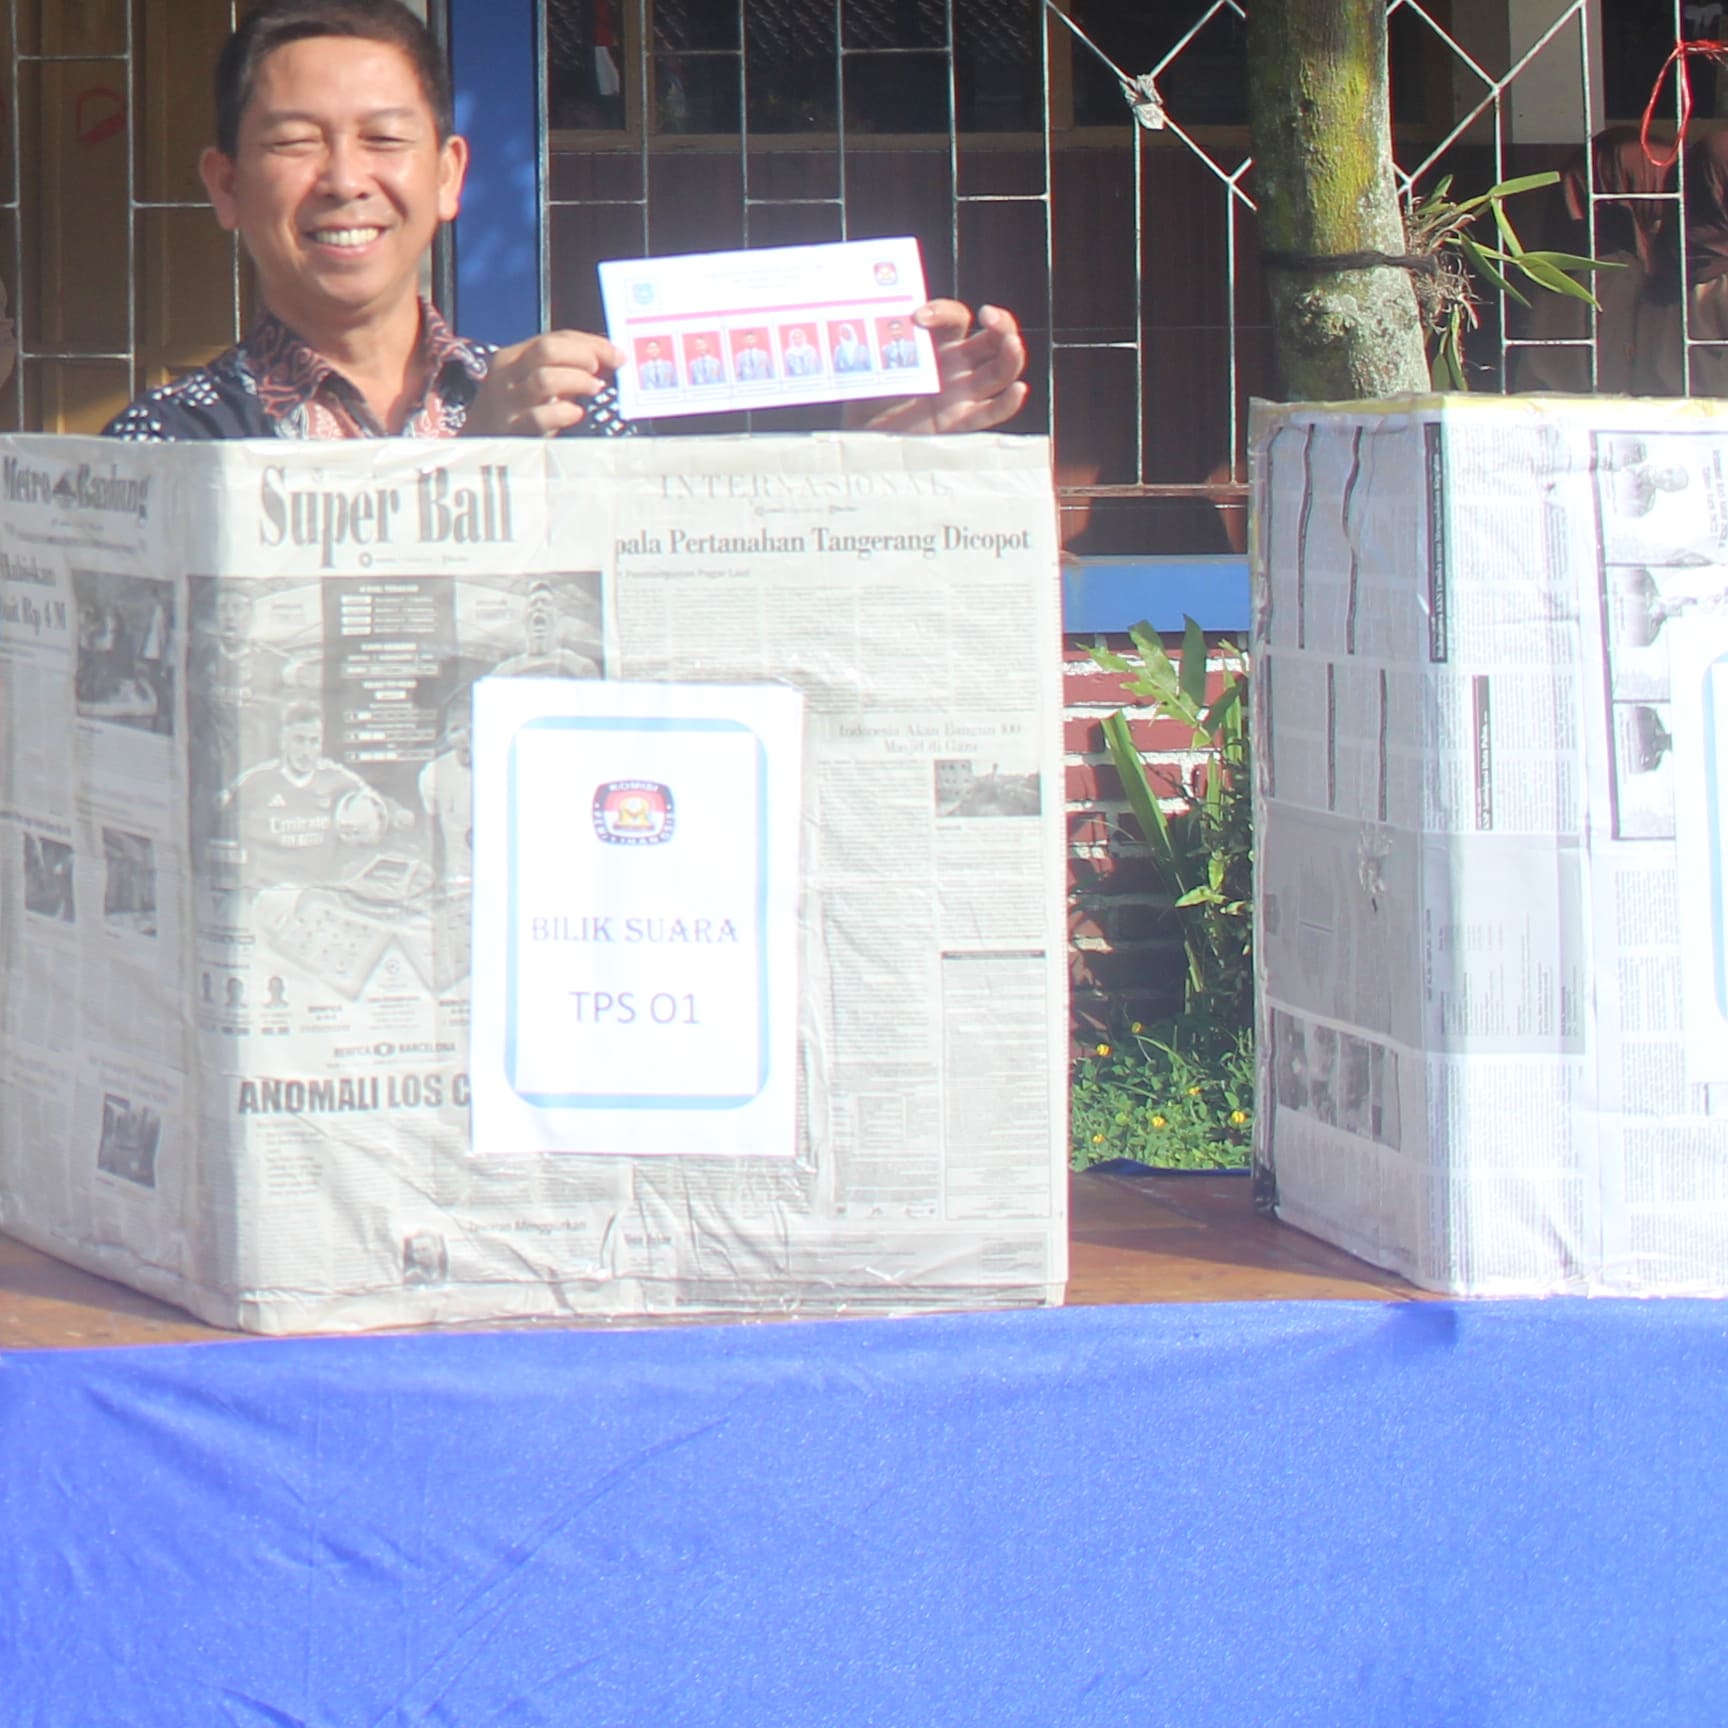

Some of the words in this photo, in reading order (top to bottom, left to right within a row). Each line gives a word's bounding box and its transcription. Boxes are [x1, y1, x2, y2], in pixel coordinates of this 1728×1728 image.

[3, 456, 51, 503] Metro
[77, 463, 152, 520] Bandung
[259, 465, 401, 567] Super
[417, 463, 514, 544] Ball
[616, 531, 662, 562] pala
[668, 527, 806, 555] Pertanahan
[810, 526, 937, 561] Tangerang
[941, 524, 1031, 560] Dicopot
[530, 917, 615, 944] BILIK
[623, 917, 739, 944] SUARA
[569, 991, 637, 1024] TPS
[238, 1075, 380, 1114] ANOMALI
[386, 1072, 442, 1110] LOS
